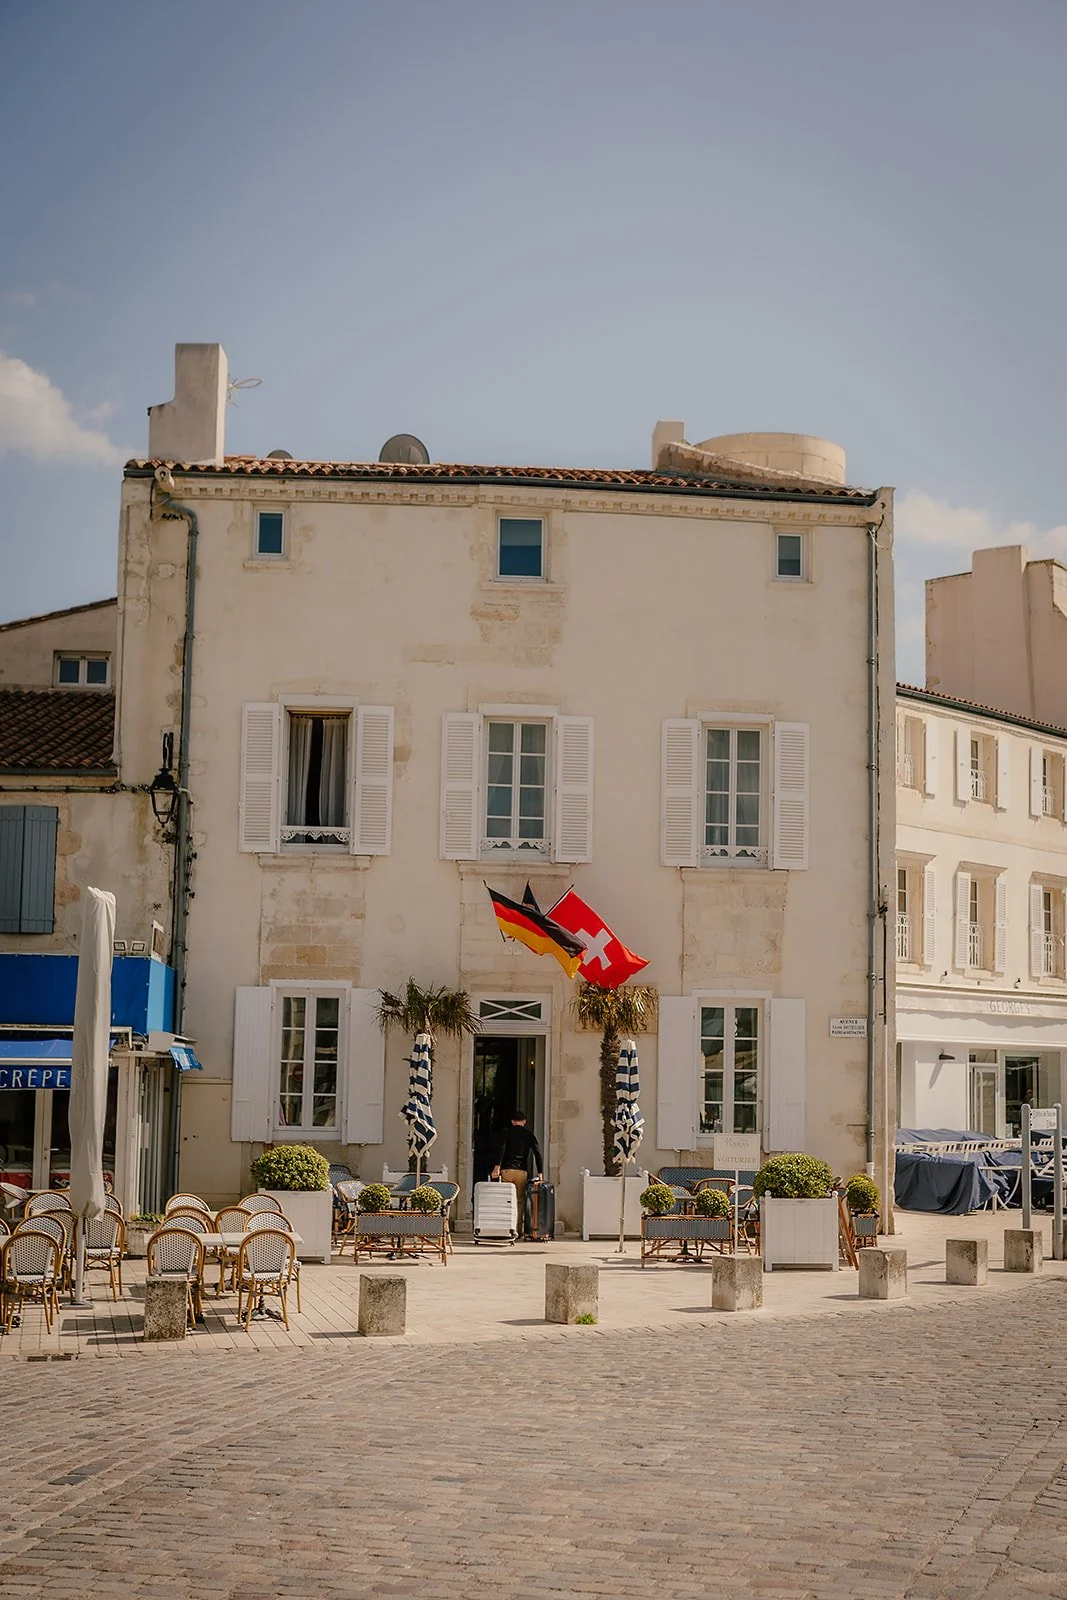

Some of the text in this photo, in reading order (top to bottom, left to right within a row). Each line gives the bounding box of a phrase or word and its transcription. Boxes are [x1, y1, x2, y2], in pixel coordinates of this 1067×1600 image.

[990, 999, 1031, 1015] GEORGES
[0, 1068, 67, 1089] CRÊPE
[717, 1156, 758, 1164] VOITURIER
